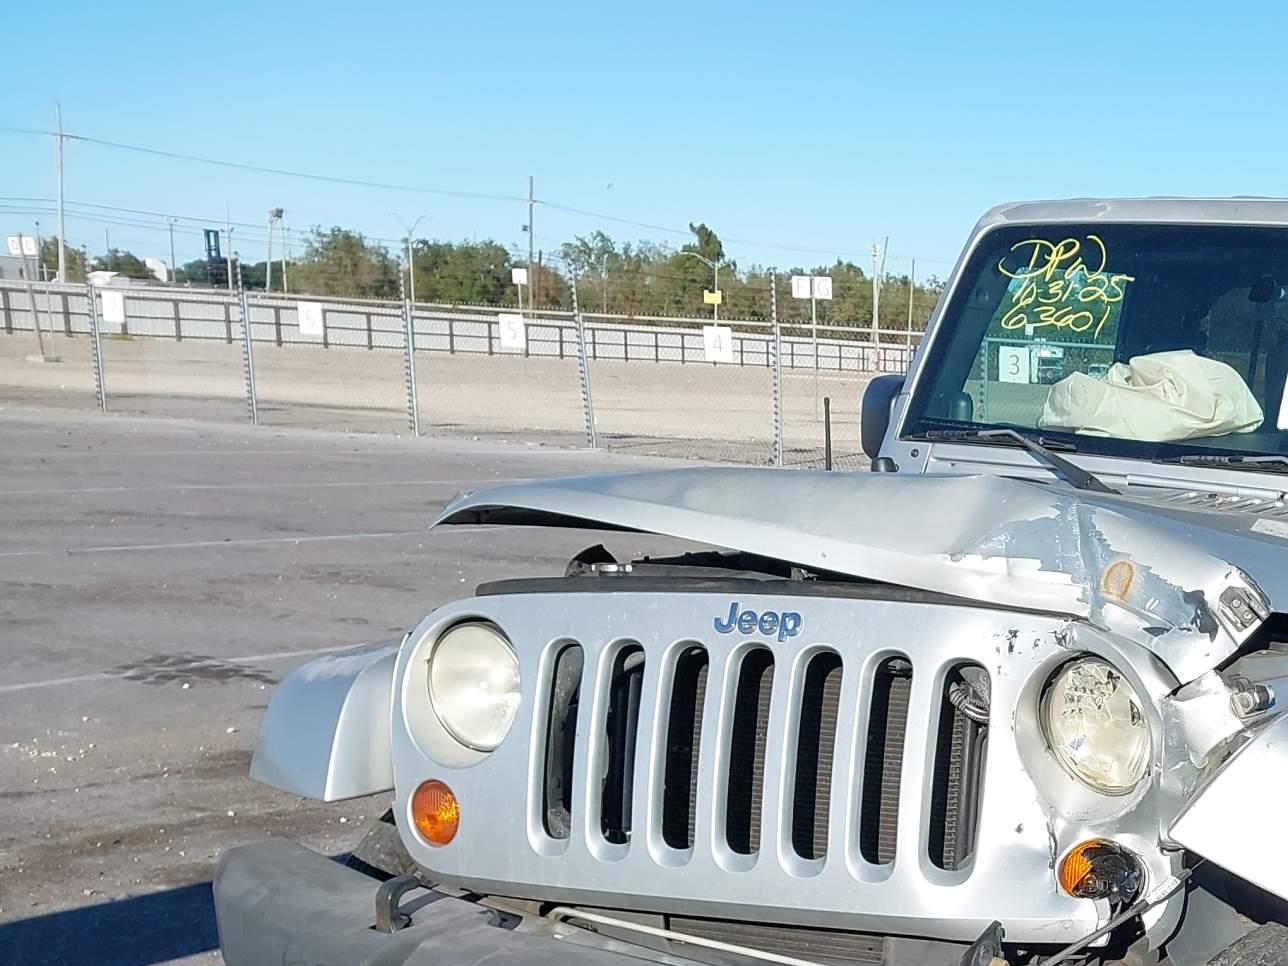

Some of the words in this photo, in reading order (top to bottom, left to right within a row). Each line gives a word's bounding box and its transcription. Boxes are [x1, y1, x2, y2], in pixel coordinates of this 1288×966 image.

[817, 279, 829, 297] G
[1008, 354, 1020, 375] 3
[713, 601, 804, 642] Jeep
